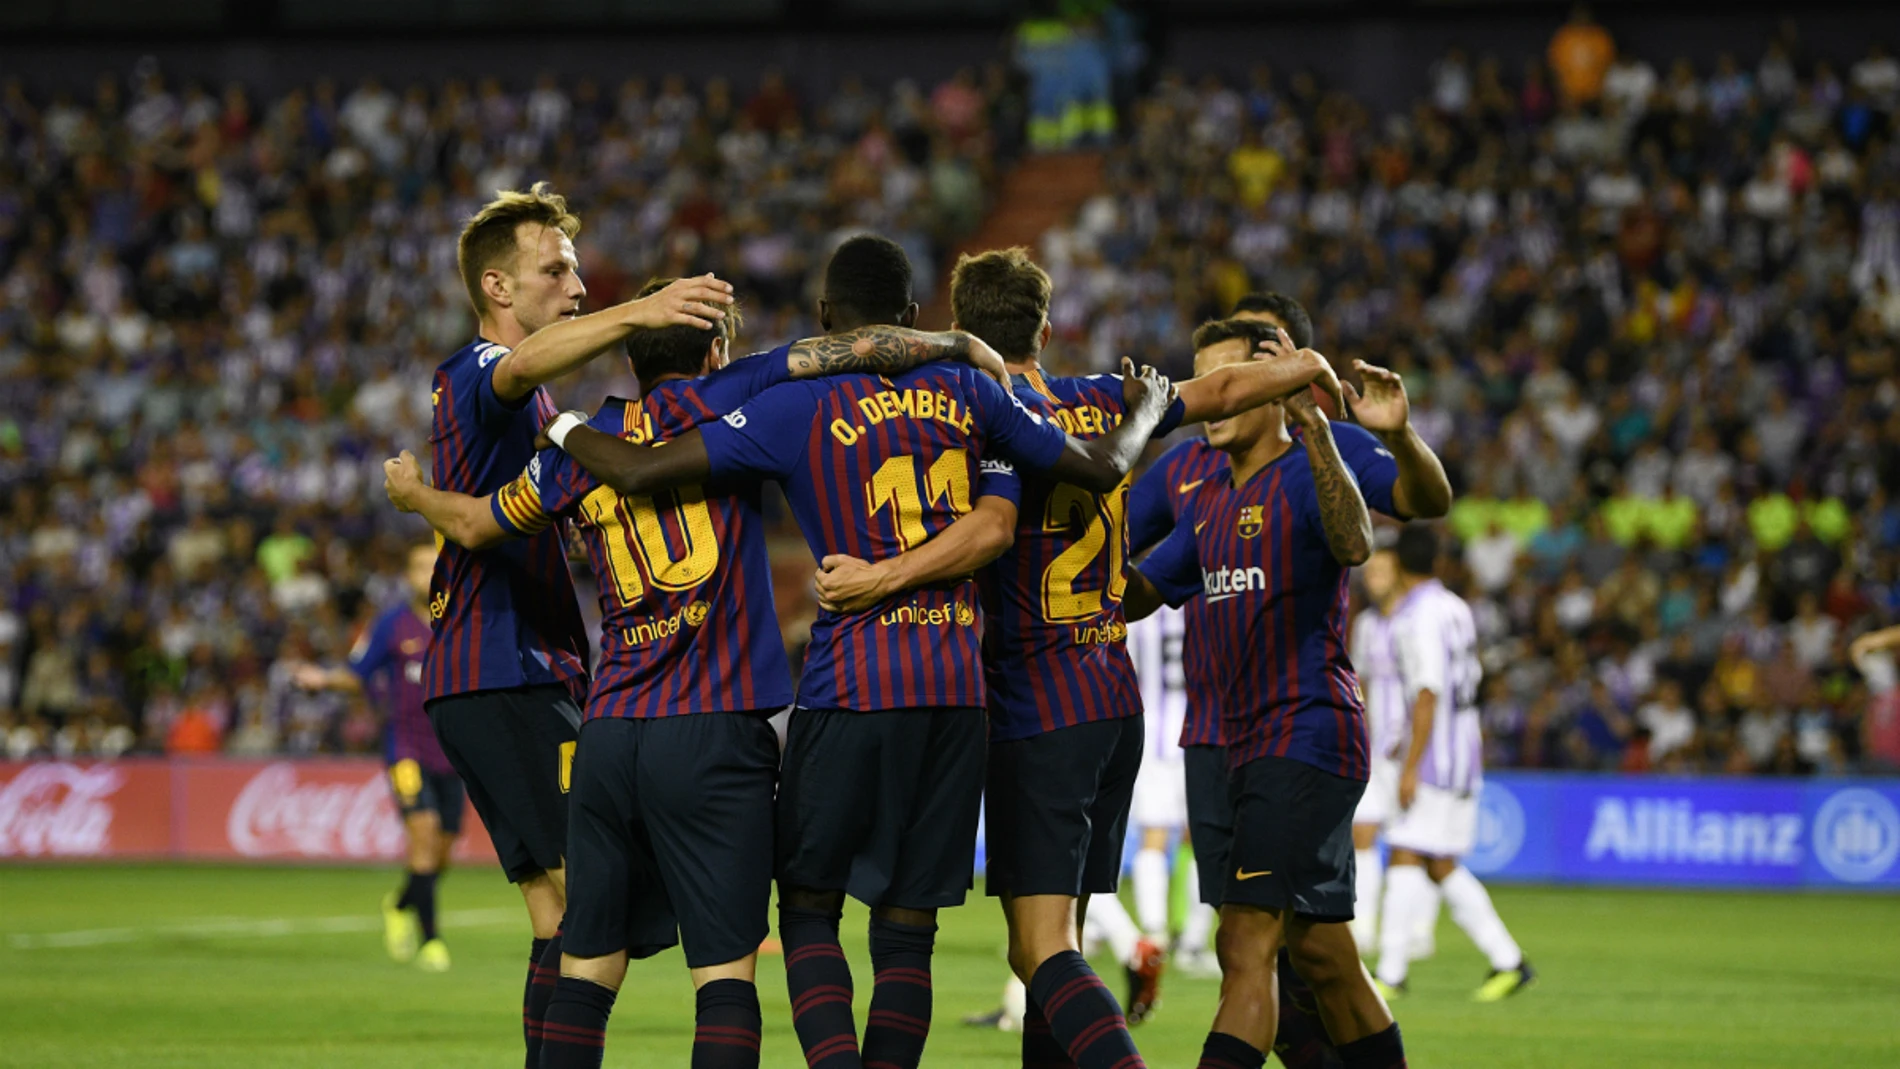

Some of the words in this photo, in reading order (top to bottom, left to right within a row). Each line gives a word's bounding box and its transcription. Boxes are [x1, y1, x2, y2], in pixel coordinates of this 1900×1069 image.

[830, 417, 866, 446] O.
[866, 448, 974, 552] 11
[579, 483, 720, 608] 10
[623, 604, 684, 646] unicef
[881, 601, 952, 627] unicef
[1586, 796, 1803, 866] Allianz
